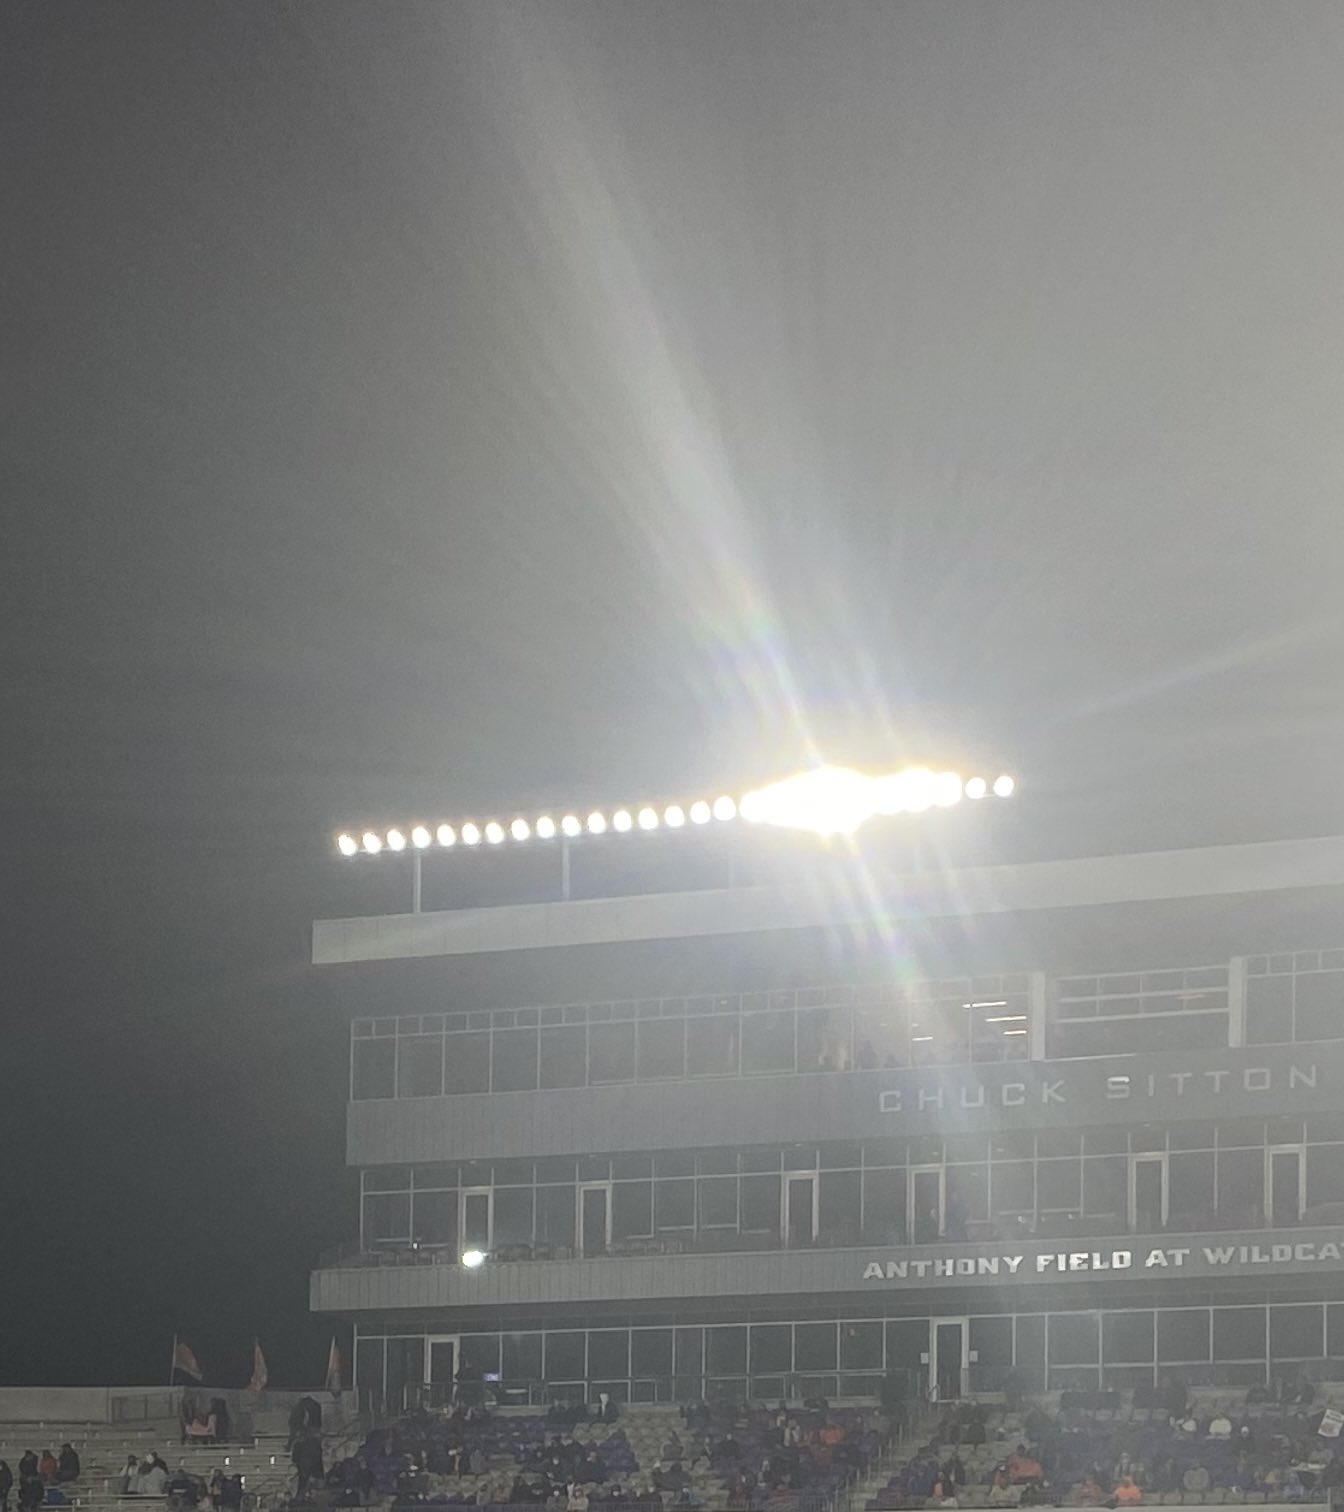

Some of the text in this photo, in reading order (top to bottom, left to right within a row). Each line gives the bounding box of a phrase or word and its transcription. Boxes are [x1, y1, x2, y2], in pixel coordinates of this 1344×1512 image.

[878, 1078, 1066, 1113] CHUCK
[1106, 1064, 1318, 1100] SITTON
[863, 1254, 1024, 1280] ANTHONY
[1036, 1249, 1133, 1273] FIELD
[1145, 1247, 1191, 1268] AT
